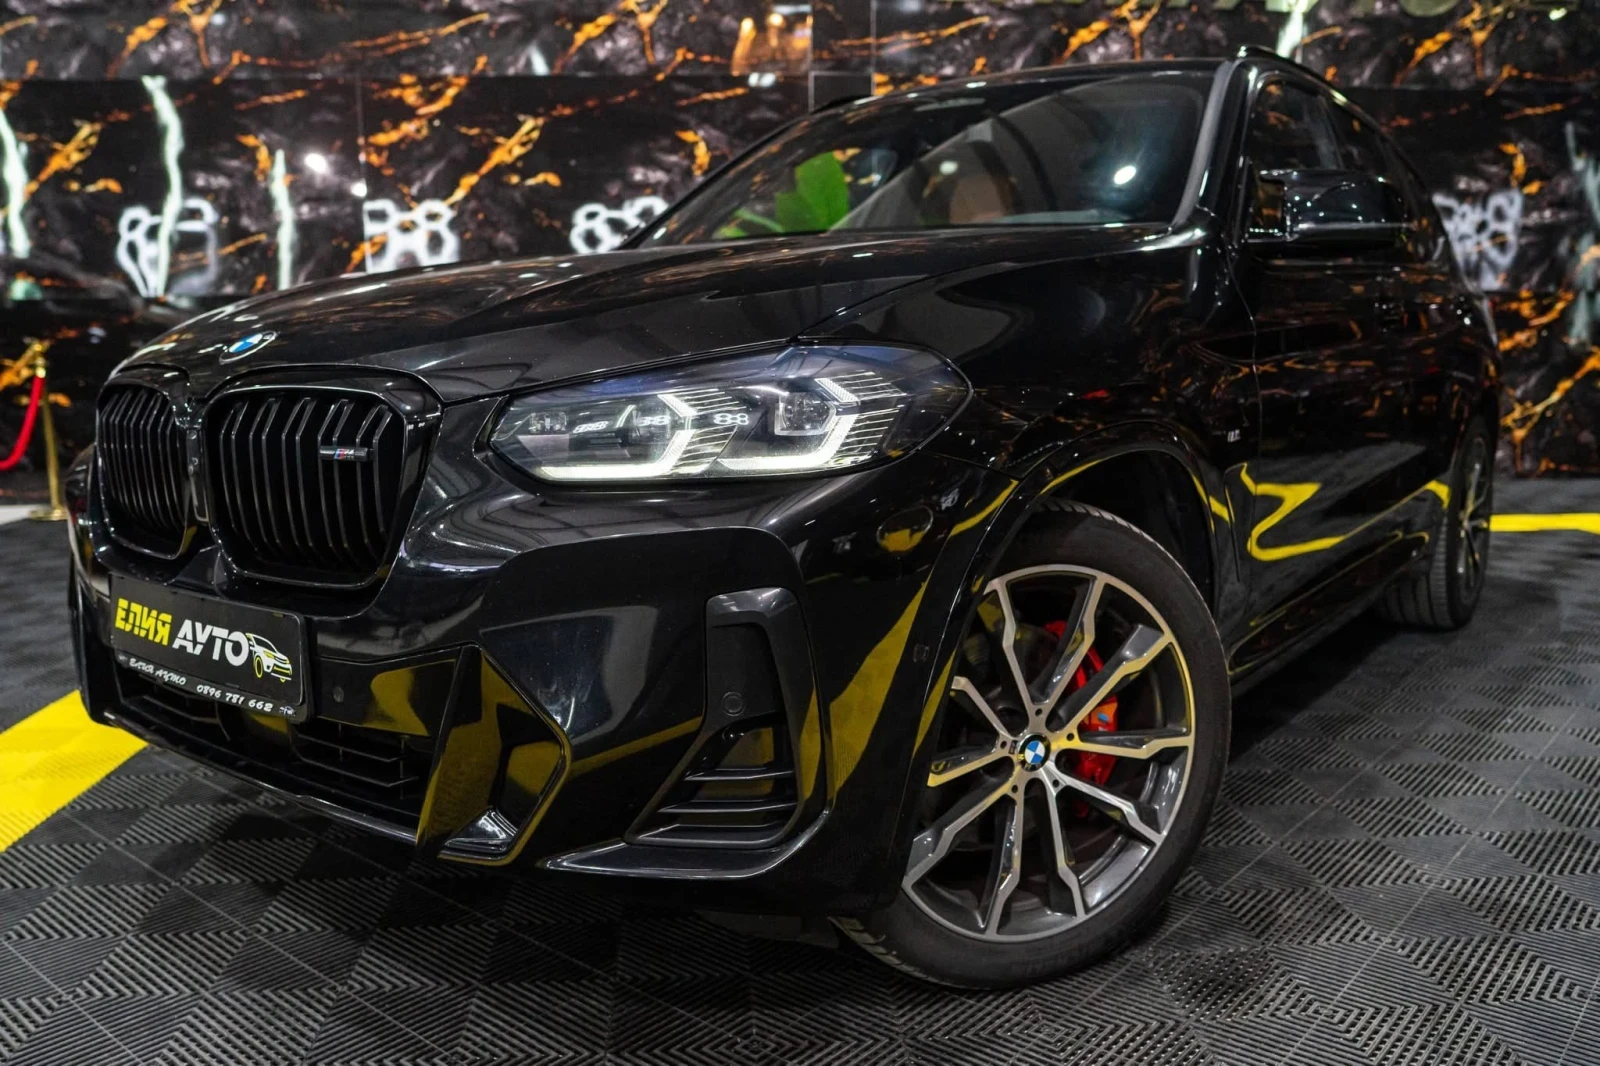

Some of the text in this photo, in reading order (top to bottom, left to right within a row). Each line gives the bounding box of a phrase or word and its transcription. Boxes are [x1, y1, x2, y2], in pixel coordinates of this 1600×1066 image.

[196, 684, 274, 712] 0896 781 662
